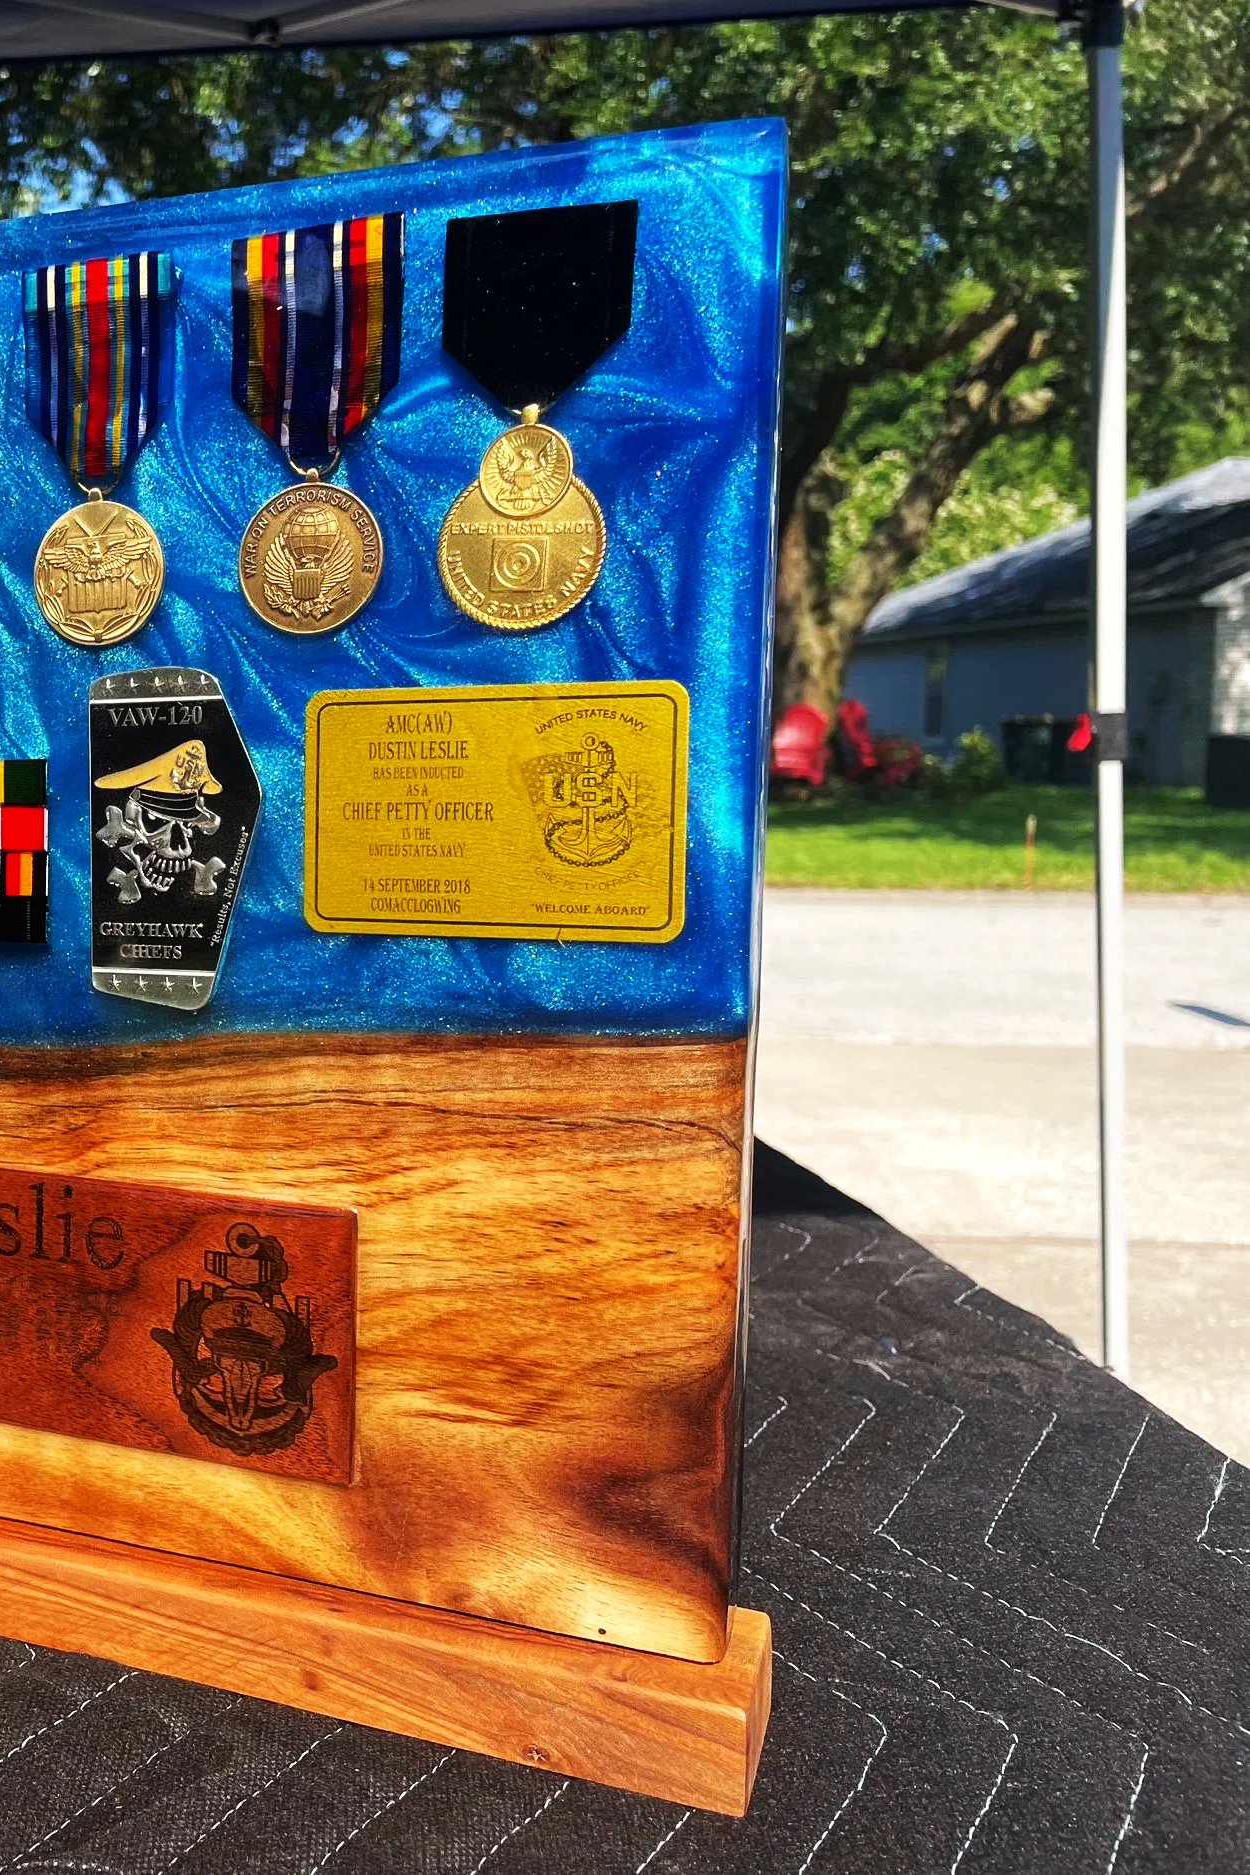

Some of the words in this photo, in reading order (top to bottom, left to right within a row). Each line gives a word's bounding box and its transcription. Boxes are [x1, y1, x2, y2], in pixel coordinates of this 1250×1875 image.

[244, 543, 258, 579] WAR
[252, 516, 269, 539] ON
[269, 489, 352, 515] TERRORISM
[351, 509, 376, 574] SERVICE
[451, 521, 507, 535] EXPERT
[446, 550, 485, 608] UNITED
[485, 595, 558, 618] STATES
[560, 545, 596, 598] NAVY
[107, 704, 203, 728] VAW-120
[385, 710, 453, 736] AMC(AW)
[534, 712, 574, 735] UNITED
[575, 708, 617, 720] STATES
[618, 712, 649, 732] NAVY
[368, 741, 416, 760] DUSTIN
[420, 740, 469, 760] LESLIE
[373, 766, 392, 780] HAS
[393, 766, 417, 780] BEEN
[420, 766, 464, 780] INDUCTED
[406, 783, 420, 797] AS
[421, 783, 429, 797] A
[542, 771, 639, 808] USN
[342, 801, 383, 821] CHIEF
[386, 799, 432, 821] PETTY
[434, 801, 494, 822] OFFICER
[402, 827, 411, 841] IN
[413, 827, 431, 841] THE
[368, 843, 401, 857] UNITED
[401, 843, 438, 858] STATES
[439, 842, 466, 858] NAVY
[223, 878, 236, 900] Not
[363, 877, 375, 893] 14
[378, 877, 441, 894] SEPTEMBER
[444, 877, 471, 895] 2018
[370, 896, 462, 914] COMACCLOGWING
[100, 920, 204, 939] GREYHAWK
[119, 943, 183, 960] CHIEFS
